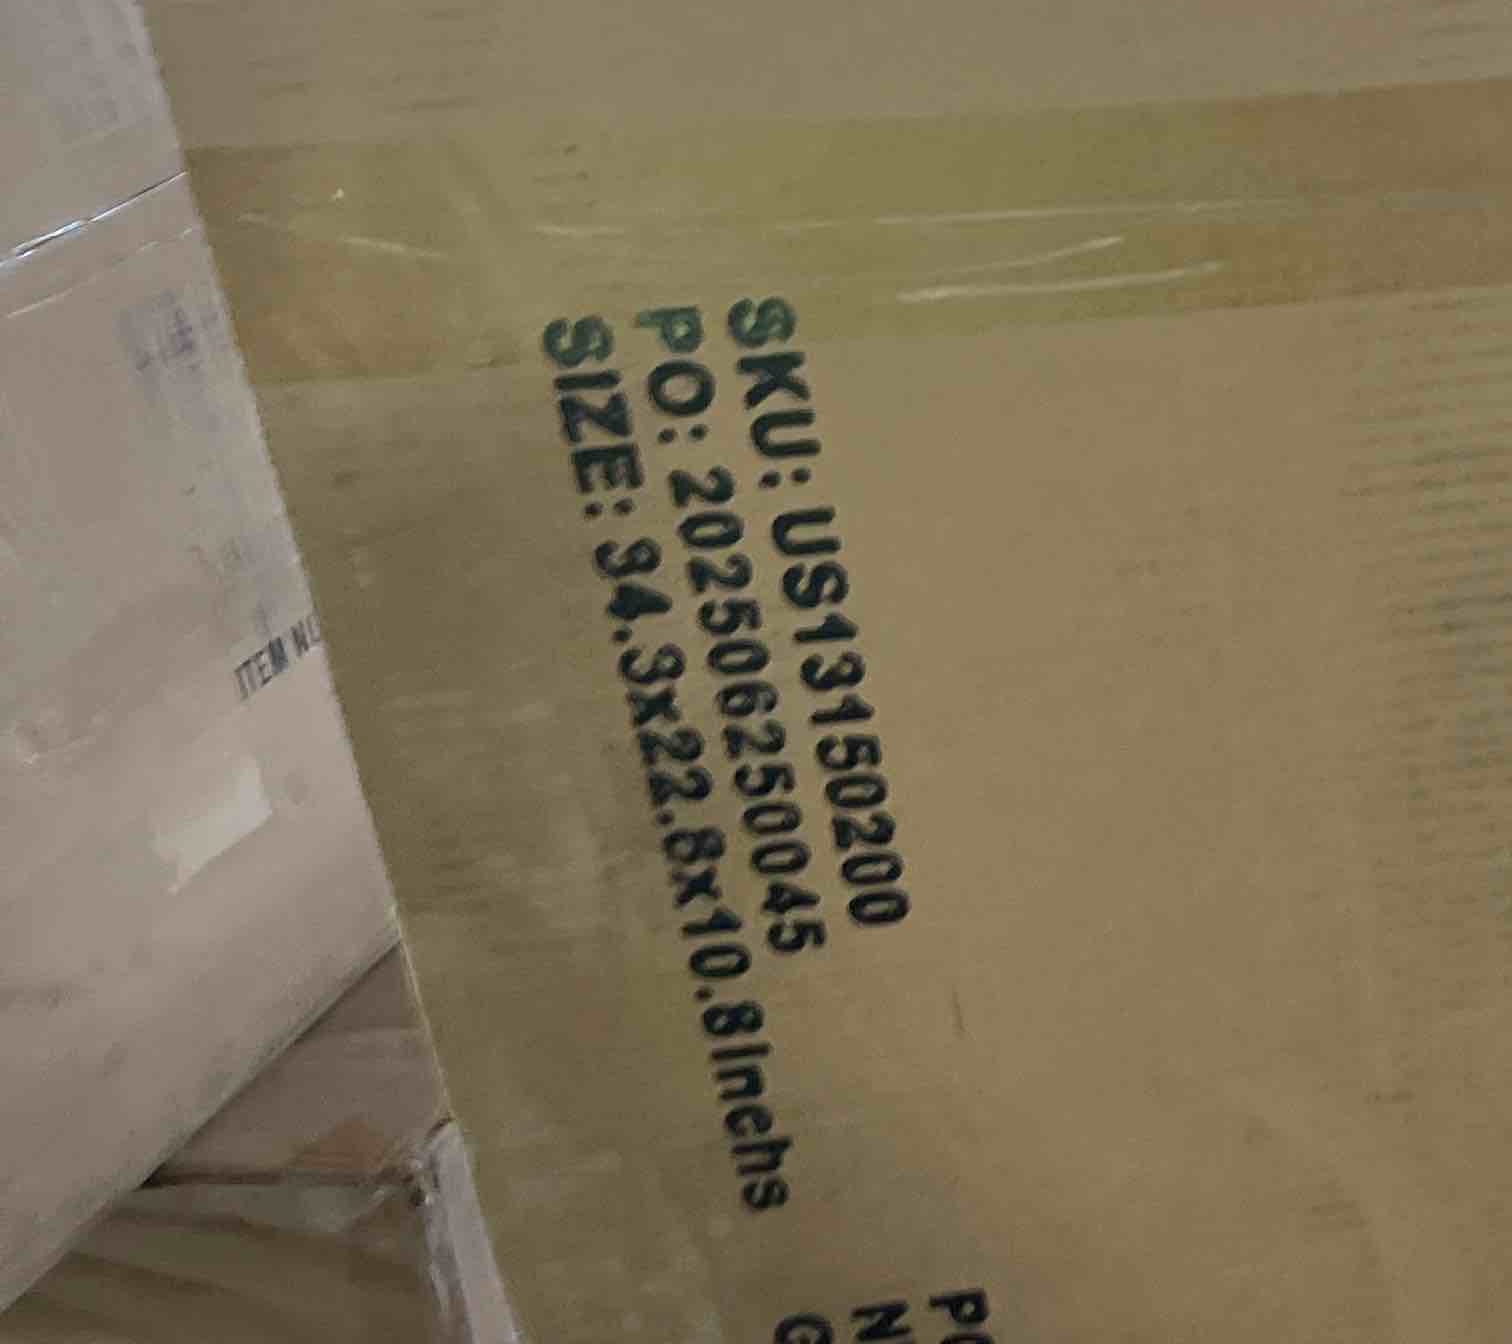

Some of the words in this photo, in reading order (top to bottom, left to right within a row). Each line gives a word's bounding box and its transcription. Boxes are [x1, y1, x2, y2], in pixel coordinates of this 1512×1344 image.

[542, 315, 645, 520] SIZE:
[635, 306, 716, 445] PO:
[727, 296, 821, 489] SKU:
[668, 465, 826, 955] 202506250045
[772, 506, 911, 926] US13150200
